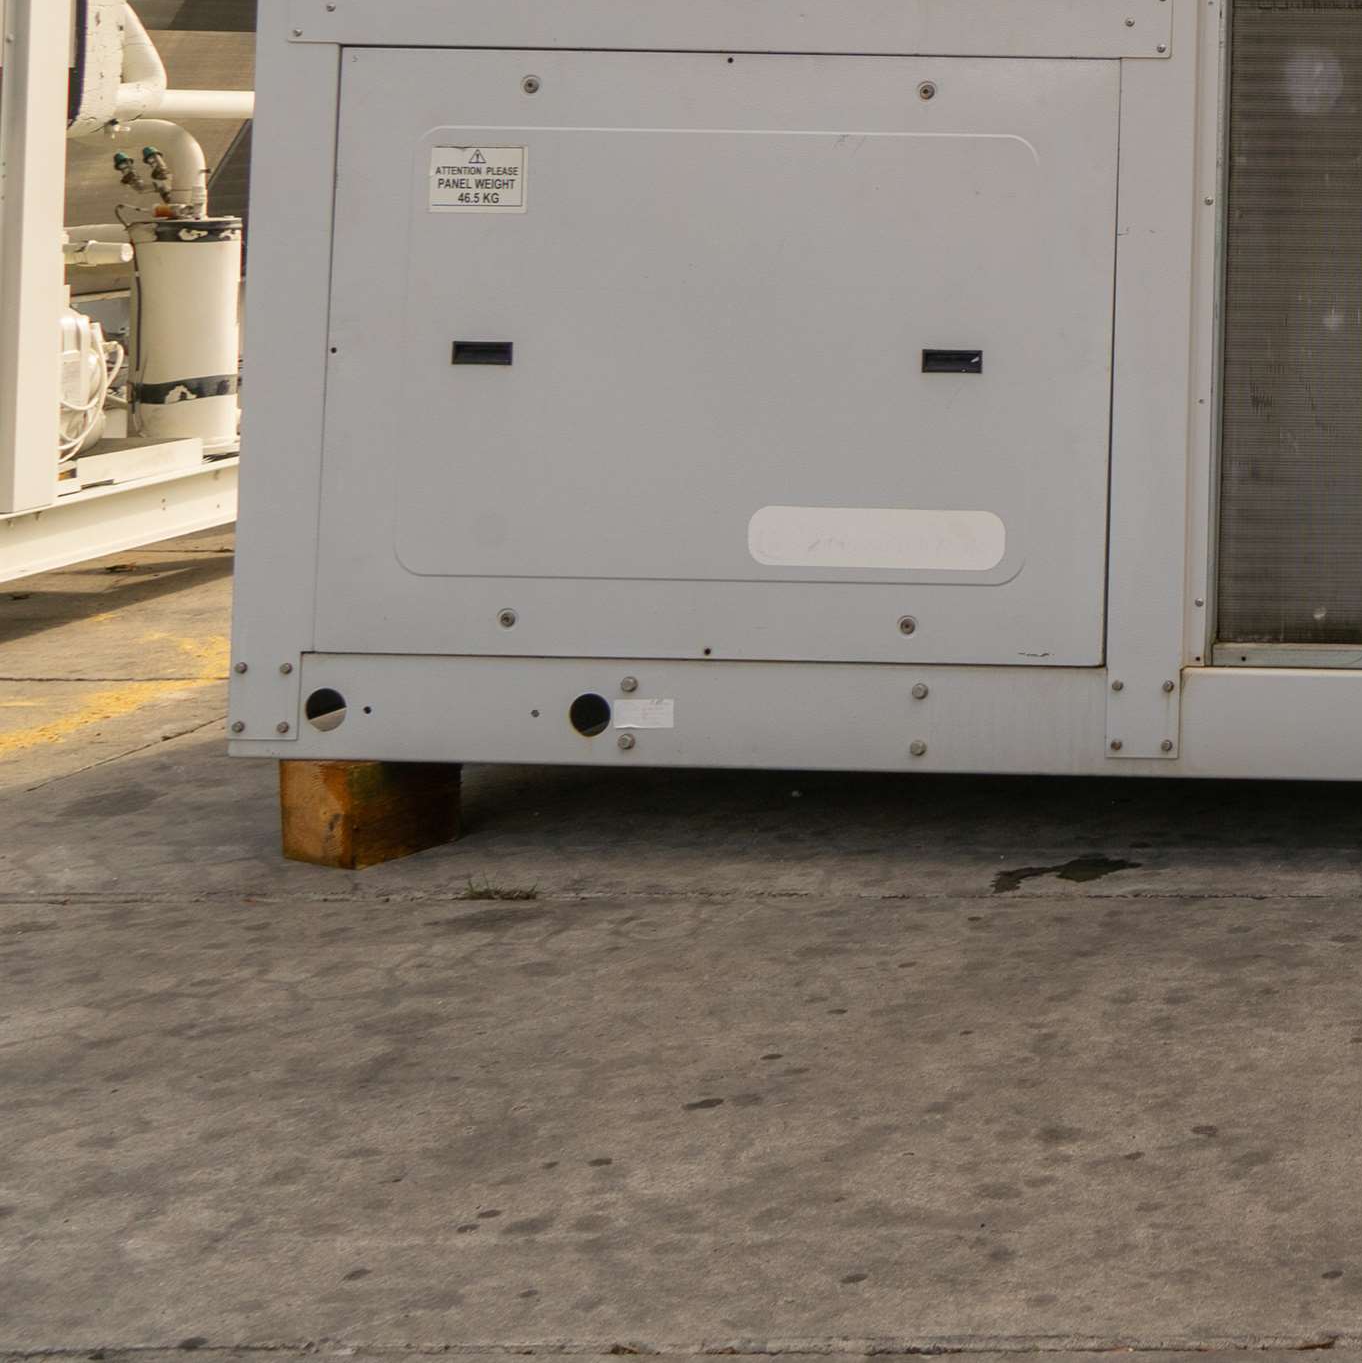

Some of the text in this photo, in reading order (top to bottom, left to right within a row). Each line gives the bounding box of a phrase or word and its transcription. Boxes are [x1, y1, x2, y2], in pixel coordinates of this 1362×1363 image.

[435, 166, 519, 176] ATTENTION PLEASE
[437, 178, 516, 190] PANEL WEIGHT
[457, 192, 500, 204] 46.5 KG
